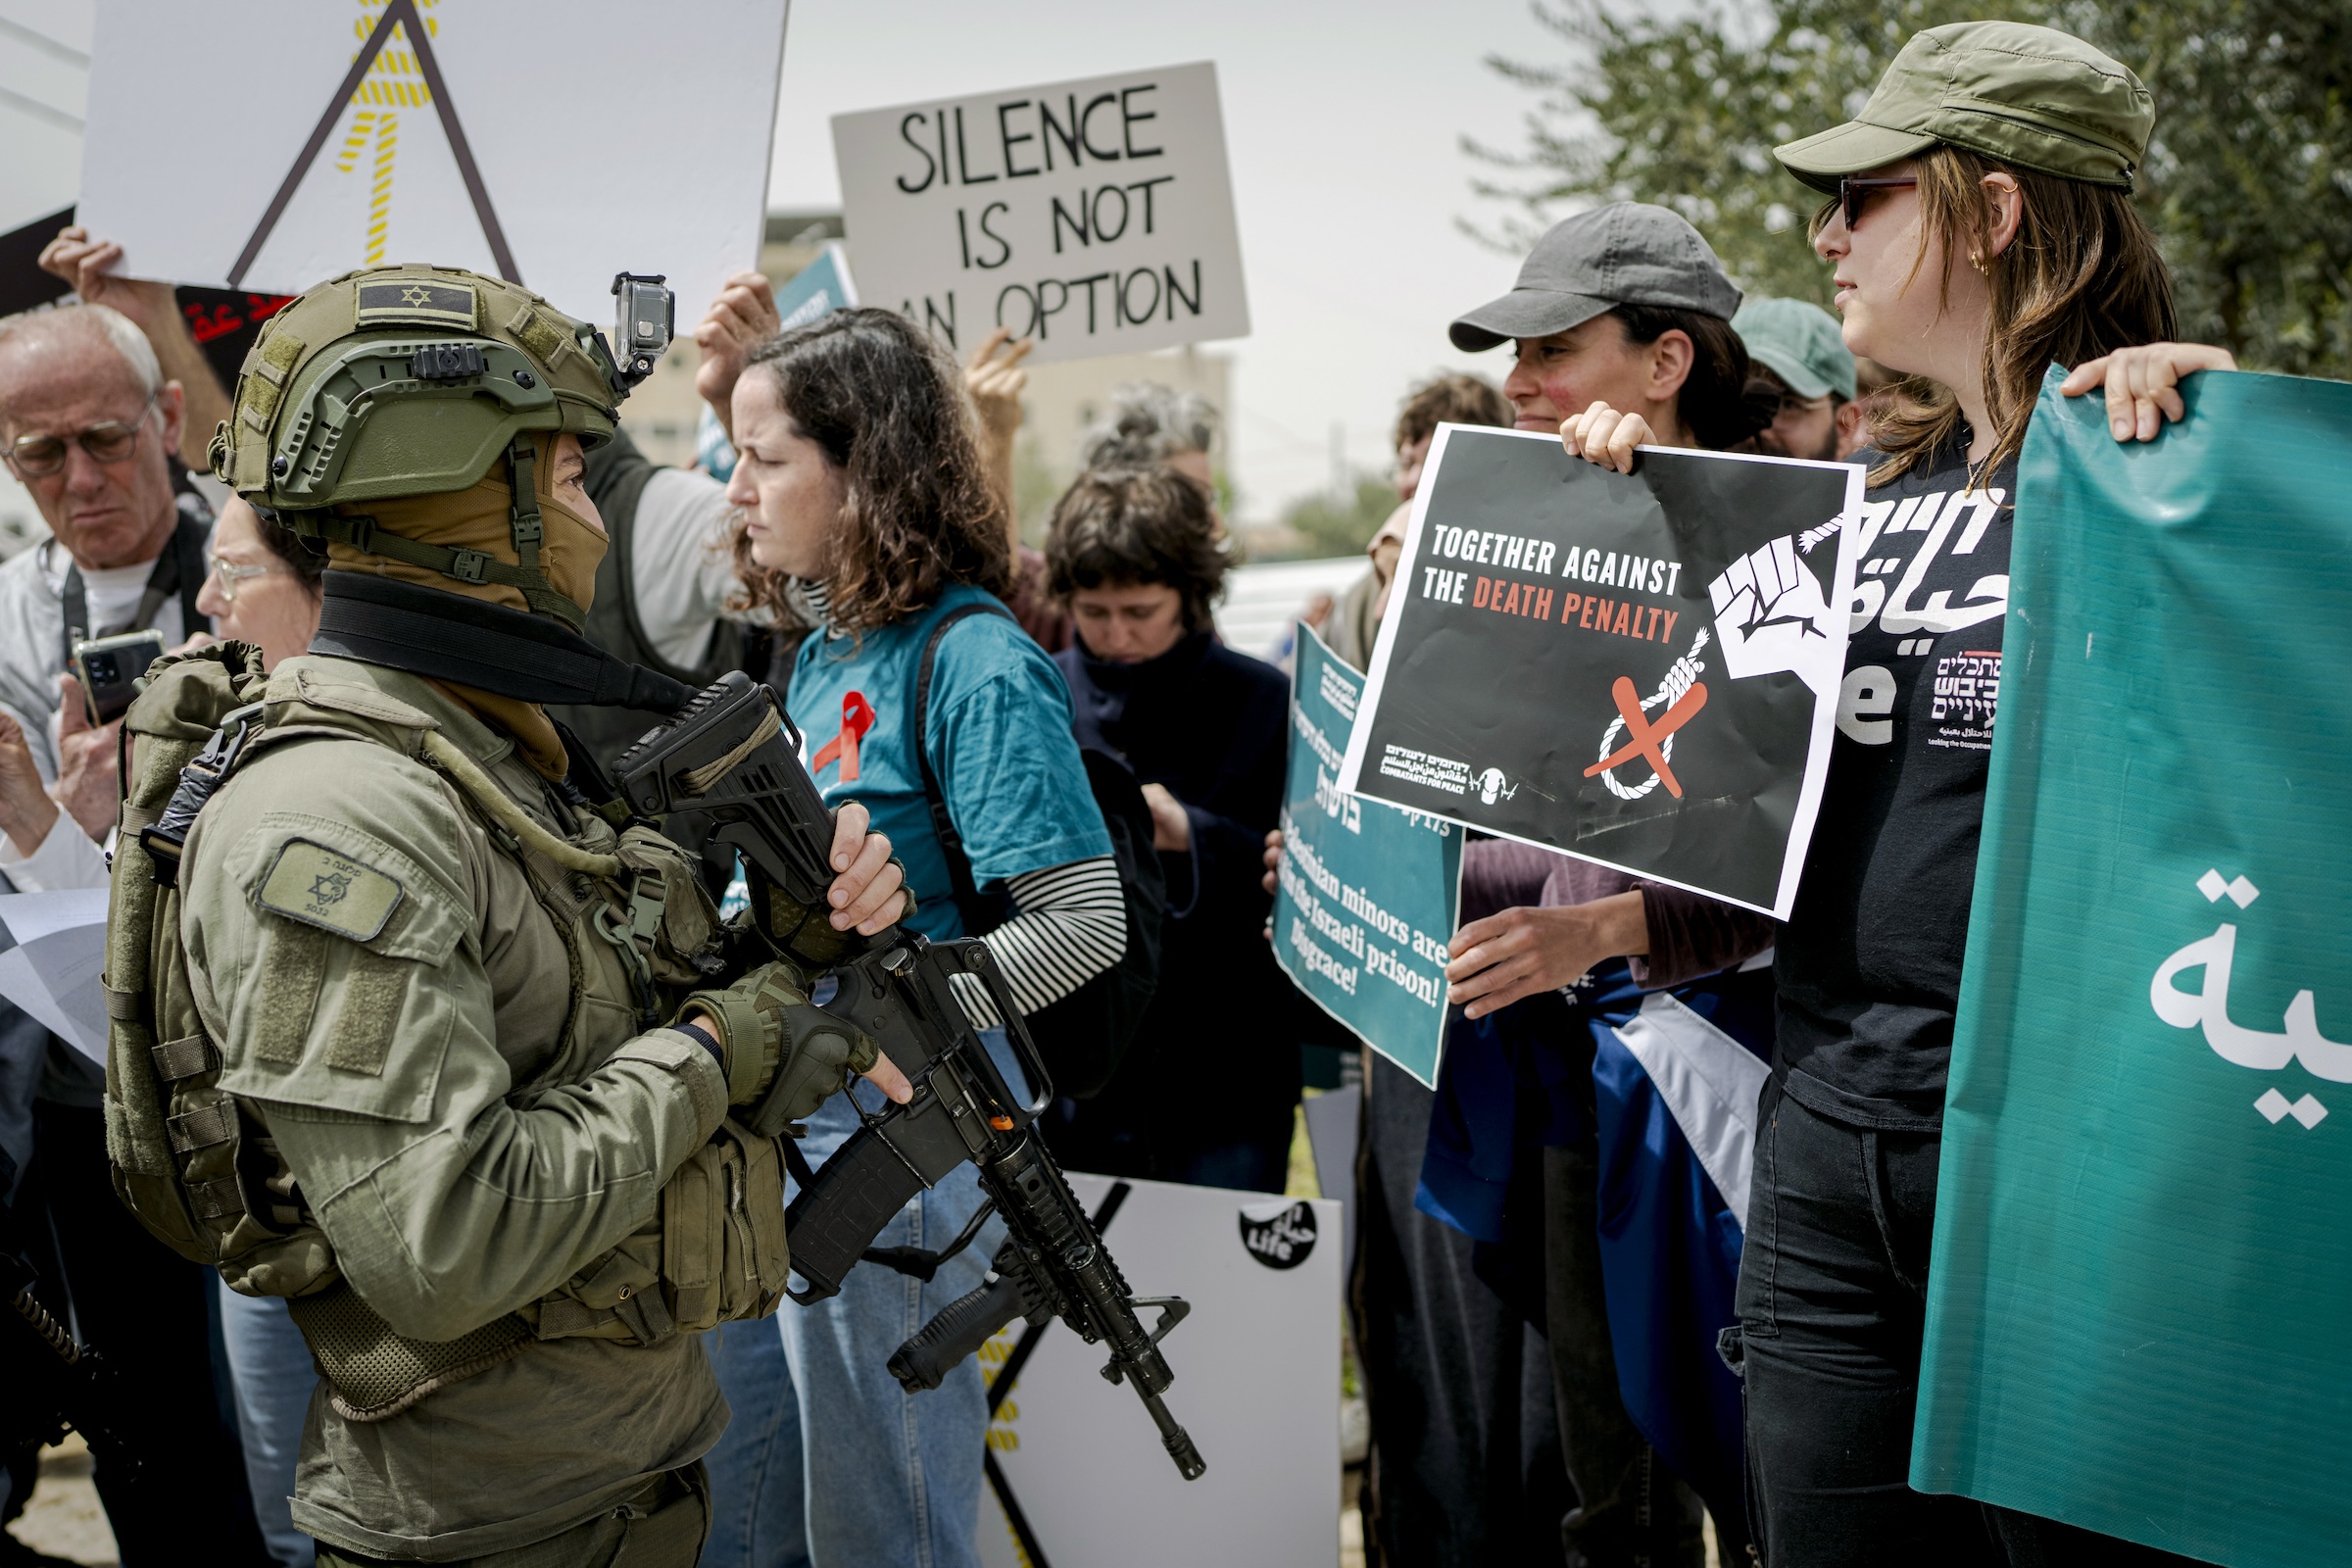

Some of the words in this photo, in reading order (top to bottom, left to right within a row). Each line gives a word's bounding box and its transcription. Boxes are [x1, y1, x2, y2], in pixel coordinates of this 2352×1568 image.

[896, 83, 1163, 194] SILENCE
[957, 202, 1011, 270] IS
[1053, 175, 1175, 255] NOT
[997, 259, 1202, 344] OPTION
[1431, 523, 1555, 575] TOGETHER
[1562, 546, 1682, 596] AGAINST
[1422, 565, 1468, 605] THE
[1472, 575, 1552, 622] DEATH
[1560, 592, 1679, 644] PENALTY
[1380, 765, 1427, 785] COMBATANTS
[1427, 777, 1442, 791] FOR
[1441, 780, 1466, 795] PEACE
[1385, 744, 1427, 761] לשלום
[1427, 755, 1470, 773] לוחמים
[1290, 915, 1358, 996] Disgrace!
[1310, 896, 1364, 960] Israeli
[1364, 943, 1441, 1007] prison!
[1341, 883, 1409, 946] minors
[1412, 930, 1448, 968] are
[1247, 1227, 1293, 1261] Life
